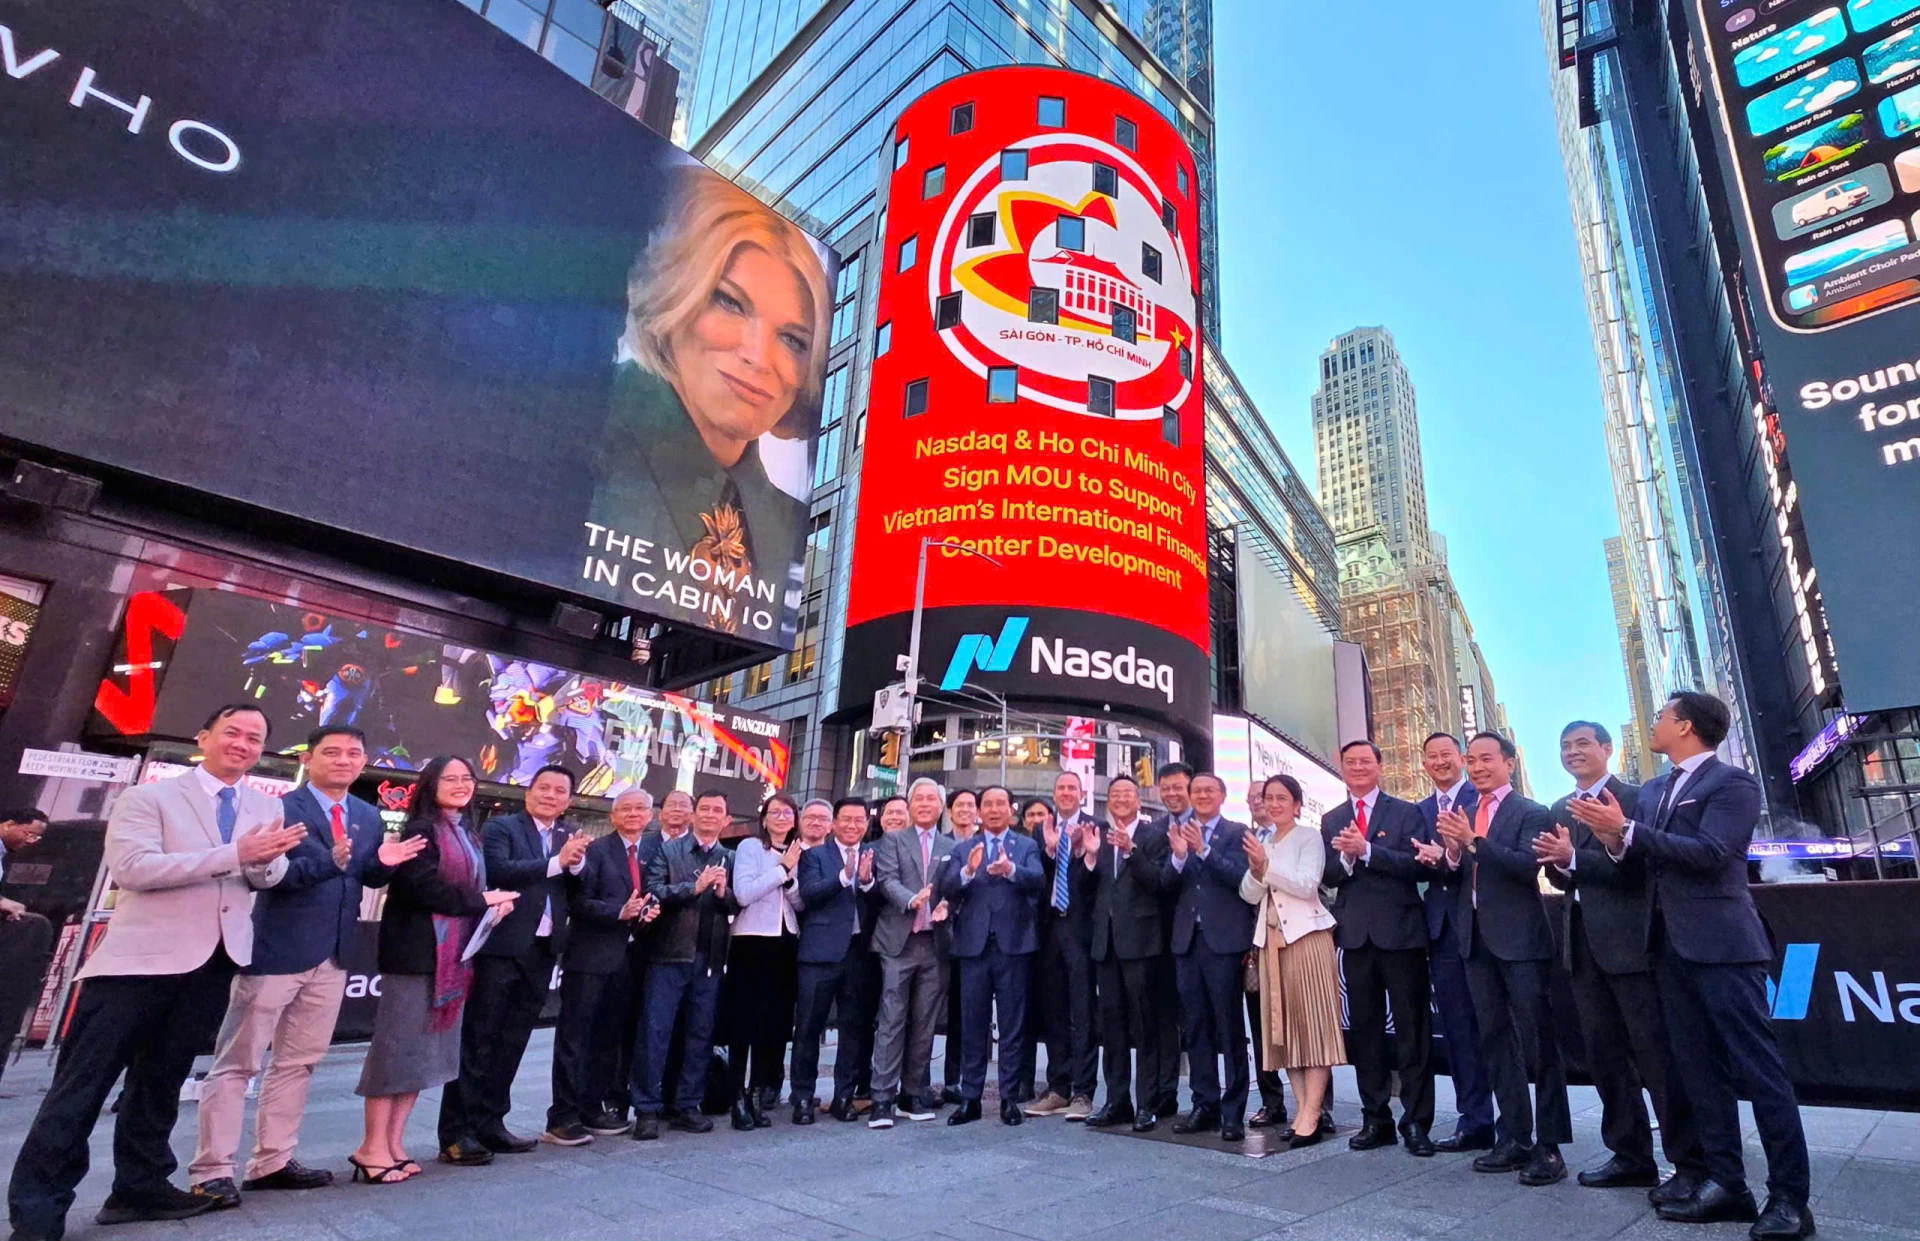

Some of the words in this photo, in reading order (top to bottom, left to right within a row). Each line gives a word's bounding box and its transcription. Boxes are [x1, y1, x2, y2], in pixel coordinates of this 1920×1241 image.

[1735, 14, 1747, 26] All
[1731, 23, 1777, 50] Nature
[1775, 65, 1798, 82] Light
[1797, 59, 1816, 72] Rain
[1886, 72, 1915, 89] Heavy
[1785, 115, 1812, 133] Heavy
[1812, 108, 1833, 121] Rain
[1796, 174, 1817, 186] Rain
[1817, 169, 1829, 178] on
[1829, 160, 1850, 172] Tent
[1812, 228, 1833, 240] Rain
[1833, 223, 1846, 232] on
[1845, 216, 1864, 227] Van
[1823, 268, 1868, 290] Ambient
[1868, 257, 1899, 273] Choir
[1825, 280, 1862, 297] Ambient
[999, 327, 1023, 340] SÀI
[1026, 329, 1056, 343] GÒN
[1126, 351, 1152, 370] MINH
[1800, 359, 1920, 410] Soun
[915, 430, 1008, 459] Nasdaq
[1014, 429, 1032, 450] &
[1039, 430, 1075, 454] Ho
[1080, 437, 1120, 464] Chi
[1124, 447, 1170, 485] Minh
[1172, 471, 1197, 506] City
[943, 465, 1000, 492] Sign
[1006, 464, 1072, 489] MOU
[1078, 472, 1103, 495] to
[1108, 478, 1184, 526] Support
[1001, 498, 1153, 542] International
[1156, 525, 1208, 579] Financial
[584, 521, 655, 565] THE
[663, 547, 776, 604] WOMAN
[941, 535, 1032, 558] Center
[1038, 535, 1183, 590] Development
[582, 555, 620, 587] IN
[631, 571, 733, 620] CABIN
[1030, 636, 1174, 704] Nasdaq
[731, 715, 781, 739] EVANGELION
[25, 763, 46, 771] KEEP
[27, 752, 77, 765] PEDESTRIAN
[79, 757, 98, 768] FLOW
[99, 760, 119, 769] ZONE
